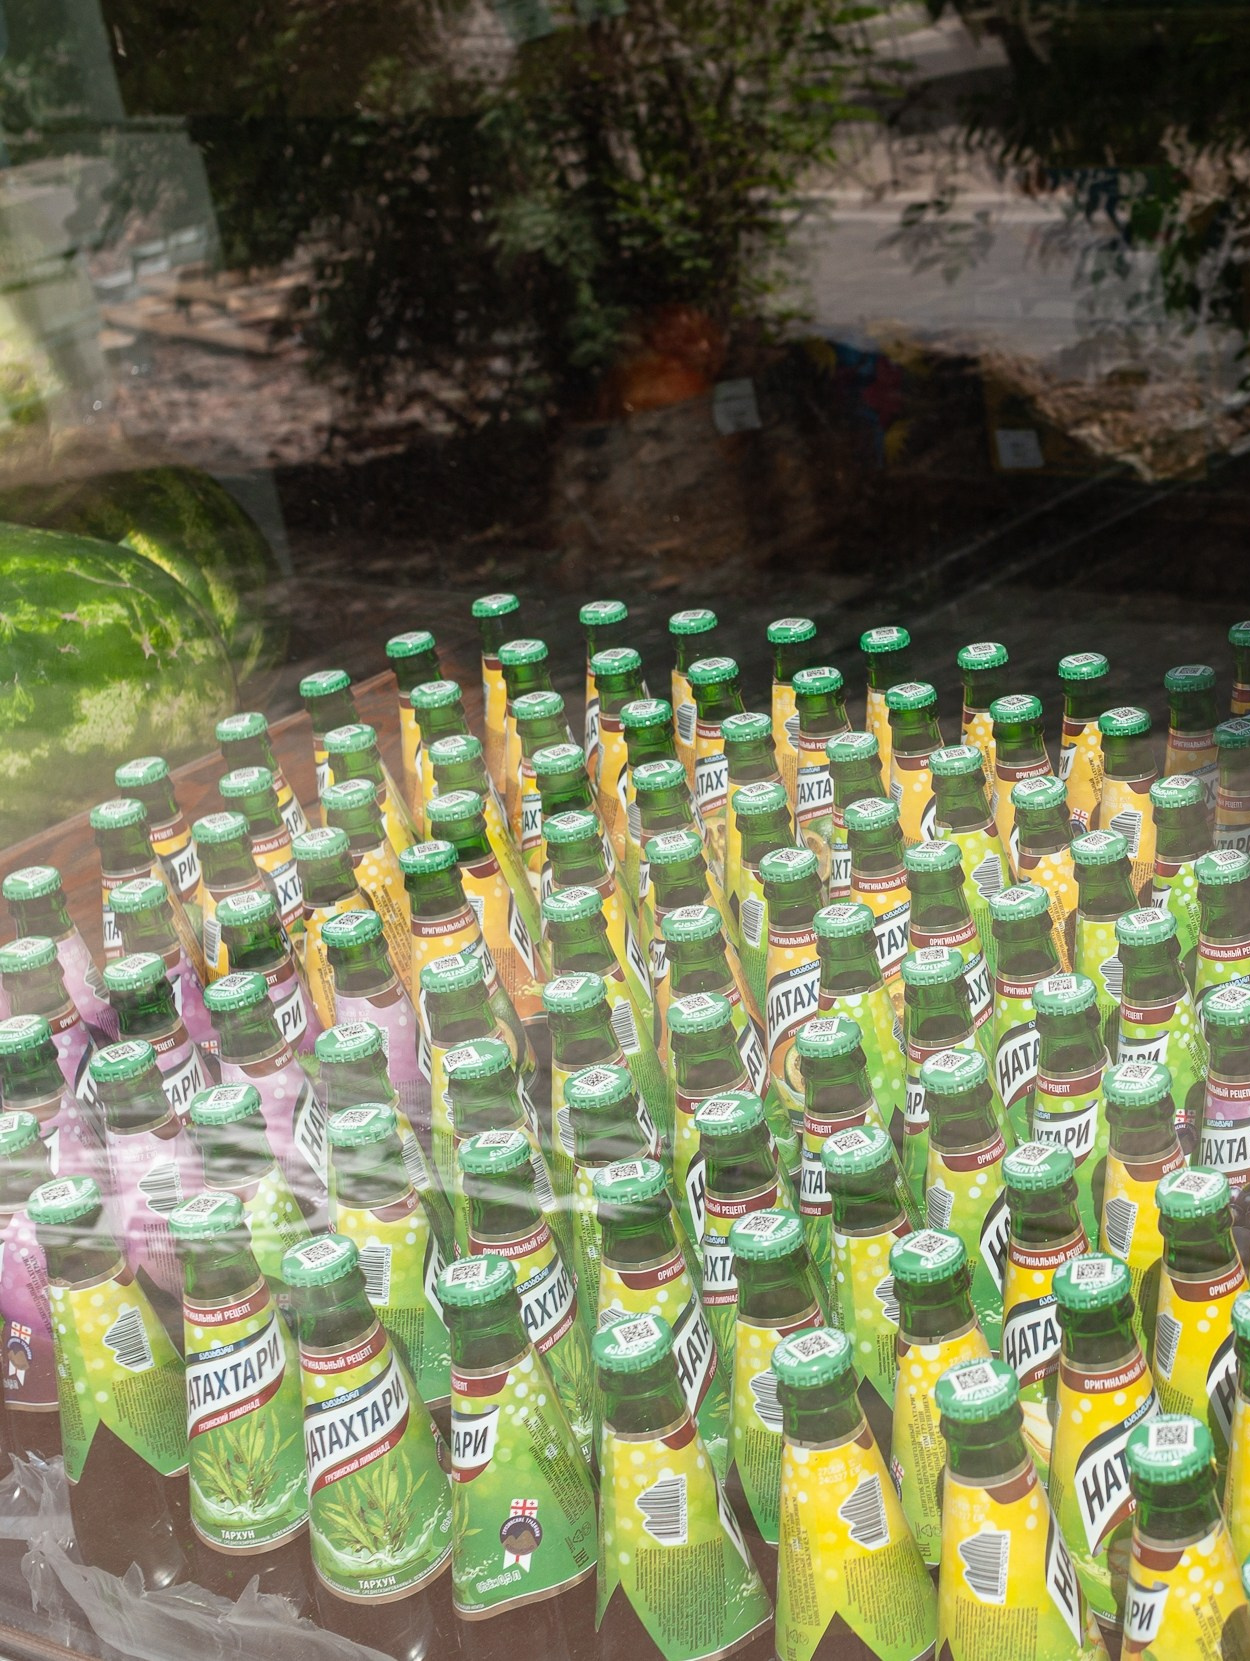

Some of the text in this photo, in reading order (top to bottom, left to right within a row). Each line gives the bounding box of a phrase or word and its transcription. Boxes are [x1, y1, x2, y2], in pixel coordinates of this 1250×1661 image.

[858, 877, 899, 889] ОРИГИНАЛЬНЫЙ
[421, 918, 465, 935] ОРИГИНАЛЬНЫЙ
[929, 929, 971, 946] ОРИГИНАЛЬНЫЙ
[1201, 946, 1241, 958] ОРИГИНАЛЬНЫЙ
[1126, 1010, 1144, 1021] РЕЦЕПТ
[153, 1037, 176, 1052] РЕЦЕПТ
[1048, 1083, 1070, 1093] РЕЦЕПТ
[811, 1121, 832, 1134] РЕЦЕПТ
[721, 1203, 747, 1215] РЕЦЕПТ
[483, 1239, 537, 1255] ОРИГИНАЛЬНЫЙ
[1012, 1249, 1064, 1266] ОРИГИНАЛЬНЫЙ
[224, 1303, 251, 1320] РЕЦЕПТ
[347, 1345, 373, 1366] РЕЦЕПТ
[187, 1331, 280, 1415] АТАХТАРИ
[1084, 1362, 1139, 1390] ОРИГИНАЛЬНЫЙ
[229, 1398, 260, 1421] ЛИМОНАД
[918, 1410, 927, 1434] ГРУШИ
[534, 1419, 552, 1445] ТАРХУНА
[324, 1440, 391, 1485] ГРУЗИНСКИЙ ЛИМОНАД
[918, 1487, 929, 1517] НАПИТОК
[558, 1497, 576, 1526] НАПИТОК
[221, 1530, 255, 1540] ТАРХУН
[358, 1576, 396, 1590] ТАРХУН
